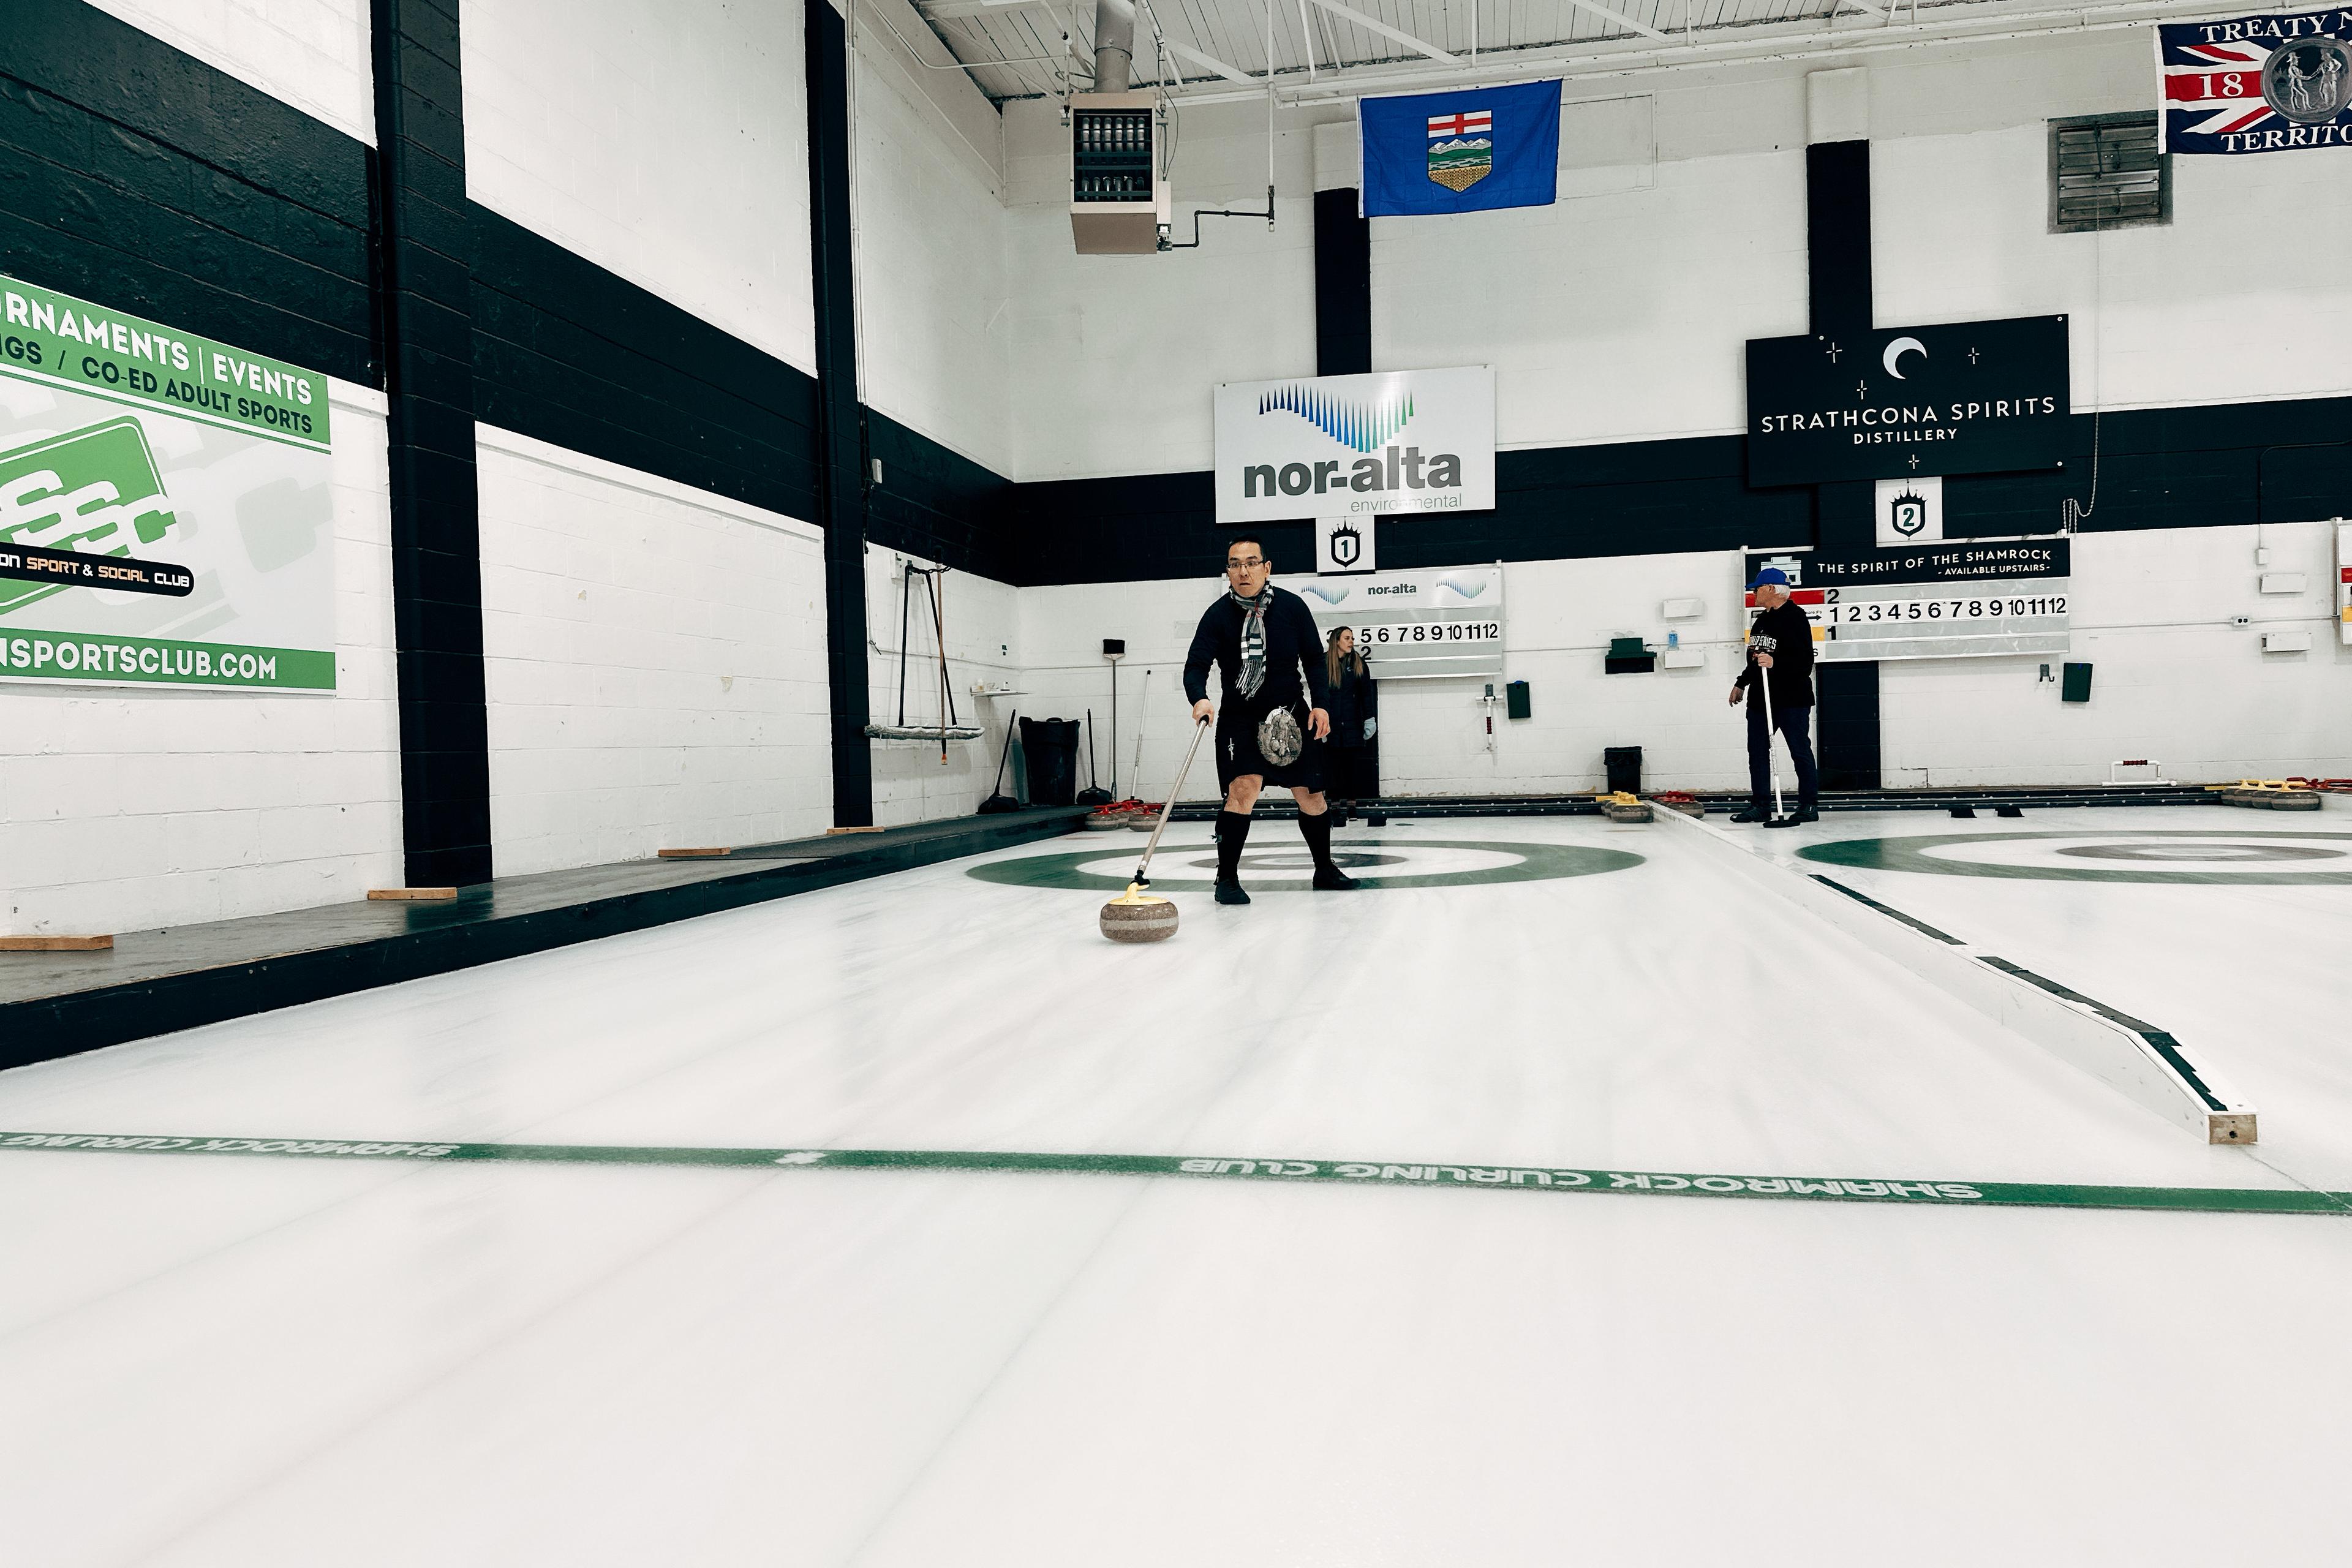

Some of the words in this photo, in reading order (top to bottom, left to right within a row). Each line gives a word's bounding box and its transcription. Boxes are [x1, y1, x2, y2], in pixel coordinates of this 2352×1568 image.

[2199, 15, 2328, 43] TREATY
[2199, 73, 2244, 99] 18
[2221, 124, 2352, 152] TERRITO
[0, 291, 189, 371] RNAMENTS
[213, 352, 312, 405] EVENTS
[81, 356, 157, 393] CO-ED
[165, 379, 232, 413] ADULT
[238, 398, 312, 434] SPORTS
[1762, 405, 1938, 432] STRATHCONA
[1951, 397, 2055, 421] SPIRITS
[1854, 428, 1958, 445] DISTILLERY
[1244, 446, 1462, 498] nor-alta
[1902, 508, 1915, 527] 2
[1341, 540, 1349, 558] 1
[26, 557, 80, 575] SPORT
[83, 564, 93, 576] &
[98, 565, 149, 583] SOCIAL
[154, 573, 190, 587] CLUB
[1817, 563, 1845, 573] THE
[1852, 560, 1899, 573] SPIRIT
[1905, 557, 1924, 568] OF
[1932, 554, 1959, 565] THE
[1966, 549, 2051, 562] SHAMROCK
[1945, 566, 1996, 575] AVAILABLE
[1368, 583, 1417, 595] nor-alta
[1827, 589, 1840, 604] 2
[1830, 607, 1838, 622] 1
[1849, 606, 1861, 622] 2
[1868, 605, 1882, 620] 3
[1888, 604, 1901, 619] 4
[1908, 603, 1921, 619] 5
[1928, 602, 1942, 618] 6
[1950, 601, 1962, 617] 7
[1969, 600, 1983, 617] 8
[1989, 600, 2003, 616] 9
[2008, 599, 2025, 616] 10
[2027, 598, 2046, 614] 11
[2048, 597, 2067, 614] 12
[1360, 628, 1372, 643] 5
[1378, 628, 1389, 643] 6
[1397, 627, 1408, 642] 7
[1413, 626, 1425, 641] 8
[1431, 625, 1443, 641] 9
[1447, 625, 1462, 639] 10
[1465, 624, 1480, 639] 11
[1483, 624, 1498, 638] 12
[1827, 625, 1837, 641] 1
[2, 1134, 192, 1150] CURLING
[187, 1138, 459, 1157] SHAMROCK
[1180, 1158, 1318, 1176] CLUB
[1335, 1164, 1591, 1186] CURLING
[1610, 1173, 1982, 1199] SHAMROCK
